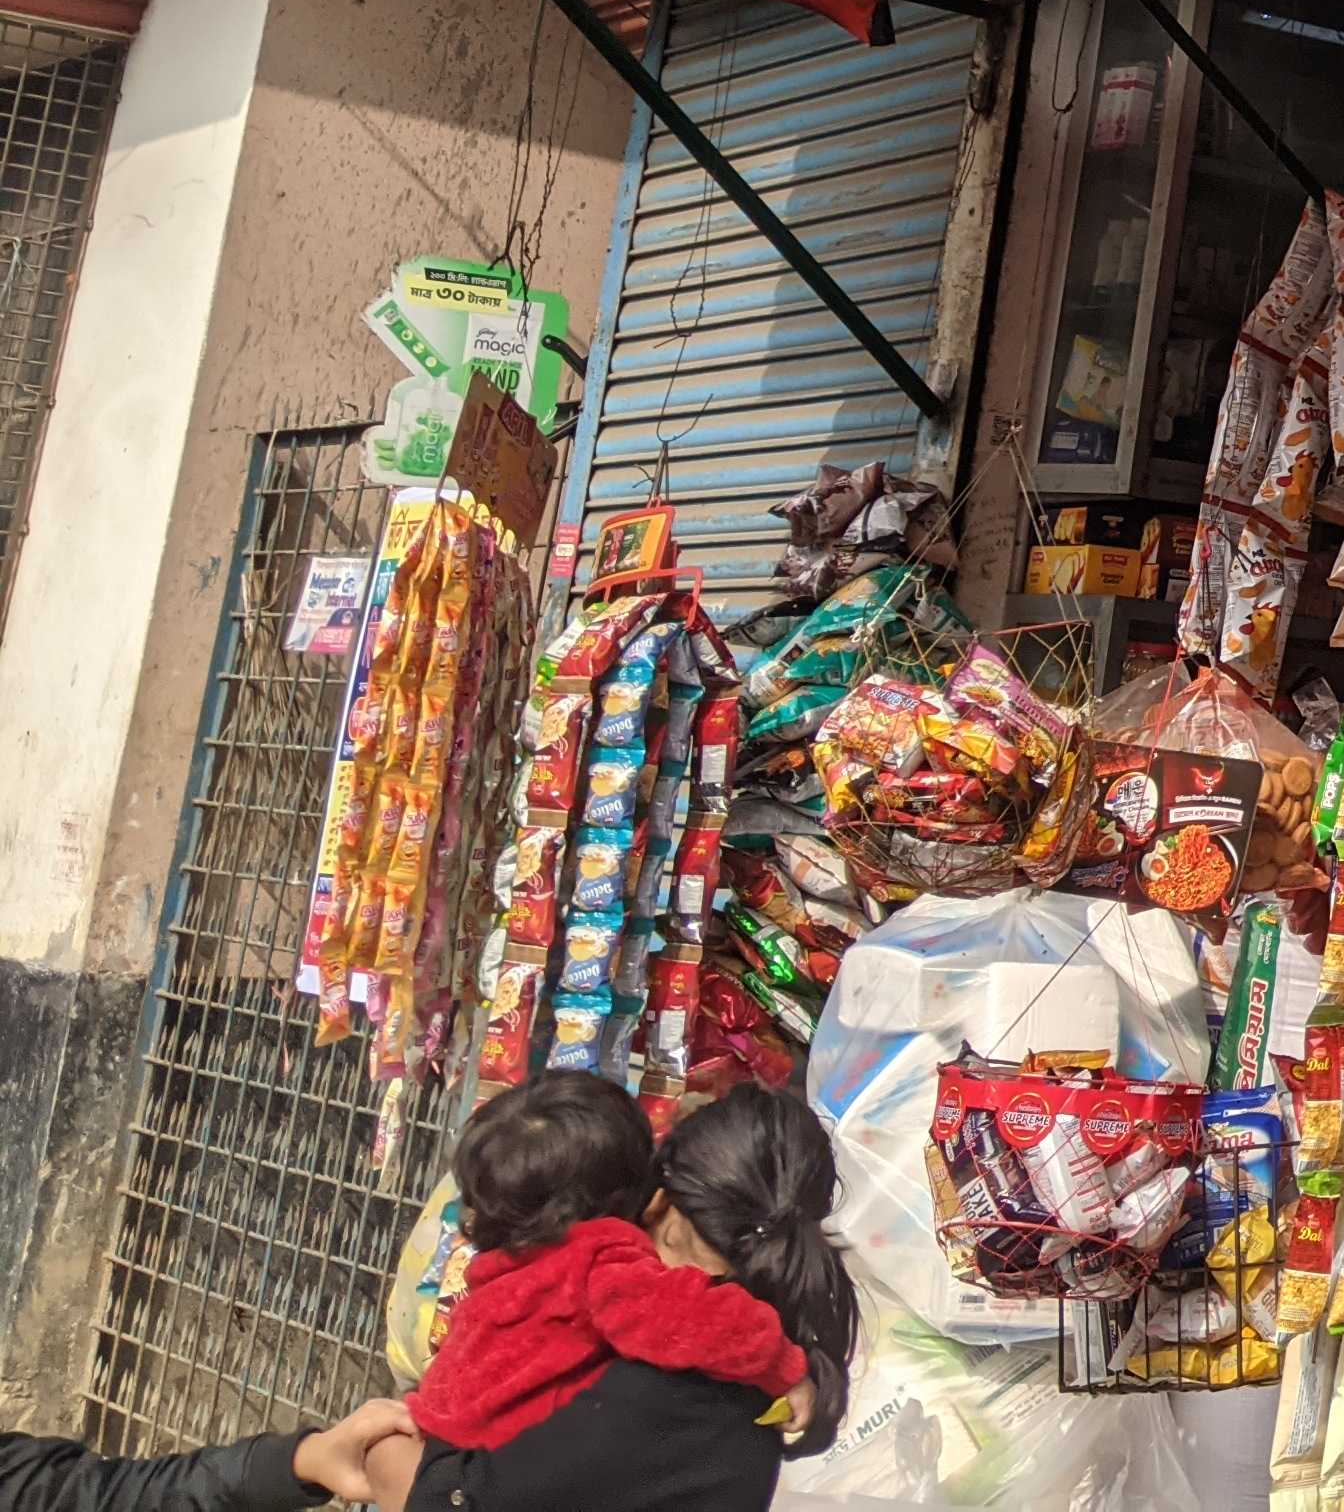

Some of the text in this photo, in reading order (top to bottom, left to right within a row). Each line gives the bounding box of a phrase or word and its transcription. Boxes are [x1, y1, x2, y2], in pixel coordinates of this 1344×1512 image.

[410, 287, 433, 299] মাত্র
[436, 288, 465, 301] ৩০
[474, 337, 525, 356] magic
[601, 717, 633, 736] Delice
[1321, 774, 1342, 809] POPS
[591, 800, 623, 818] Delice
[580, 885, 613, 901] Delice
[568, 965, 600, 979] Delice
[556, 1050, 588, 1064] Delice
[1307, 1057, 1330, 1073] Dal
[1003, 1112, 1049, 1126] SUPREME
[1085, 1119, 1129, 1134] SUPREME
[1298, 1225, 1323, 1243] Dal
